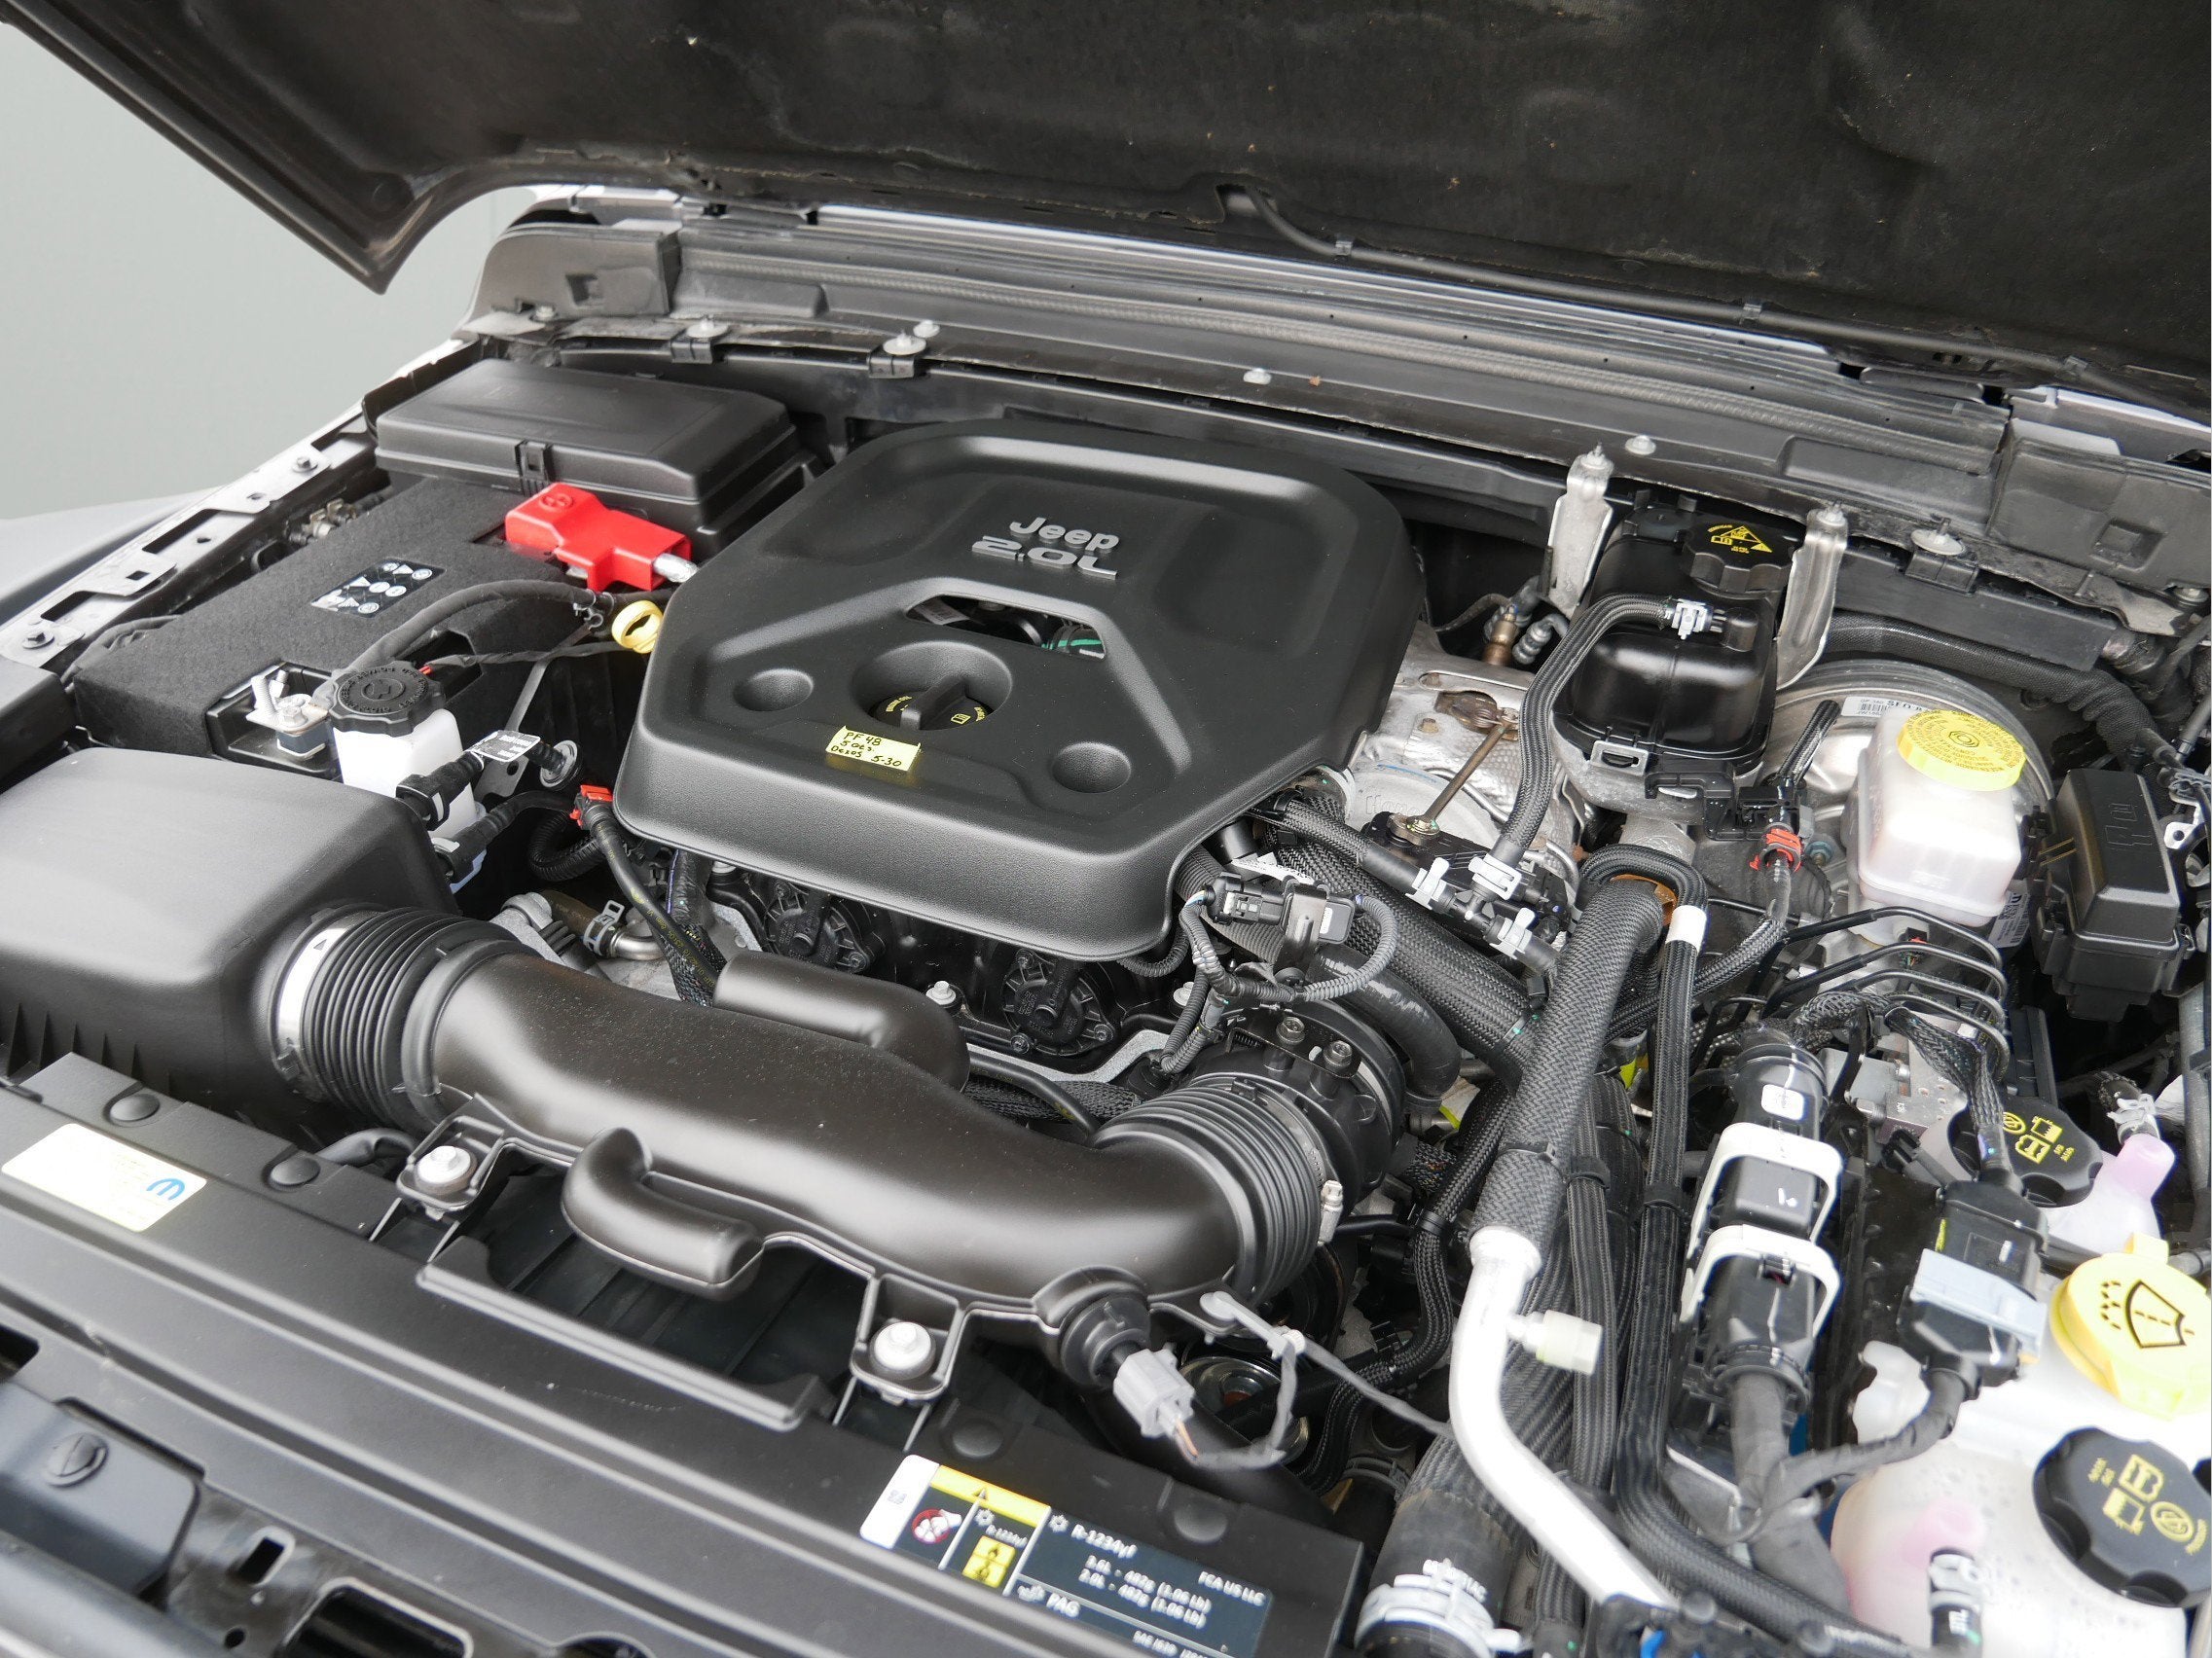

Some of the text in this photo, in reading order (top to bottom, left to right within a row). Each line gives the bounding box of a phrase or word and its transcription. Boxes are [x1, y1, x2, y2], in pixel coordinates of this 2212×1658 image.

[1009, 517, 1119, 553] Jeep
[972, 535, 1117, 580] 2.0L
[843, 731, 882, 746] PF 48
[870, 755, 902, 767] 5-30
[1071, 1524, 1138, 1558] R-1234yf
[1046, 1593, 1080, 1618] PAG
[1198, 1571, 1265, 1606] FCA US LLC
